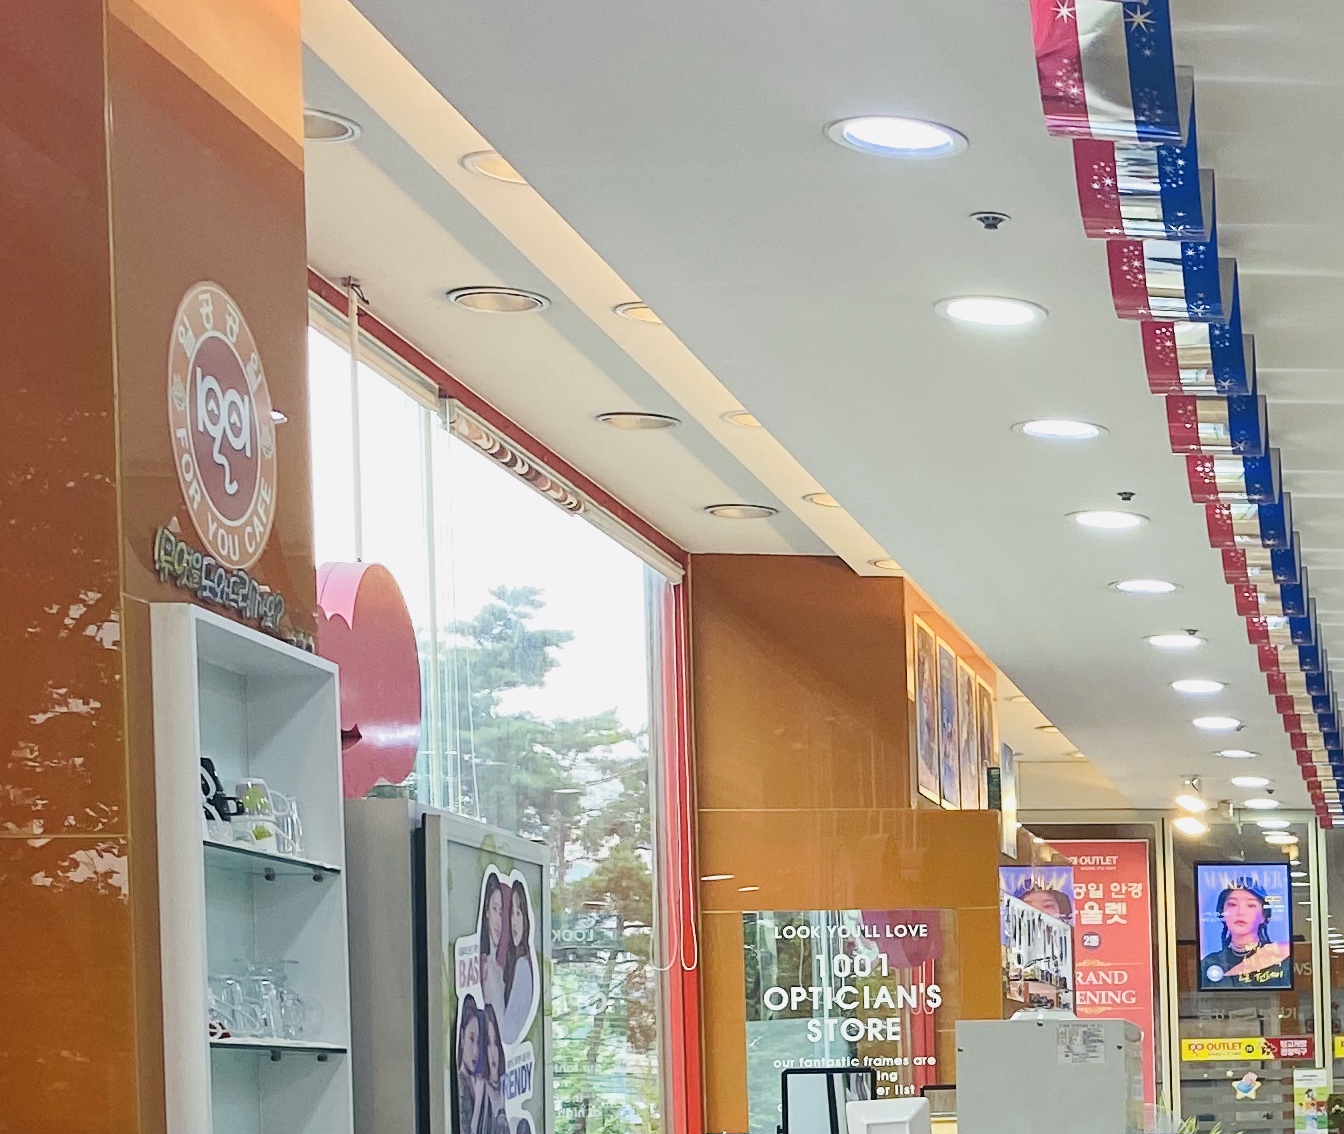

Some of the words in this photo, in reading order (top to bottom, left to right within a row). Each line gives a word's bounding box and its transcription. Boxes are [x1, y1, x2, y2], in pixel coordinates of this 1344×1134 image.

[175, 427, 202, 510] FOR
[206, 511, 240, 562] YOU
[244, 483, 273, 554] CAFE
[1079, 855, 1118, 865] OUTLET
[1074, 883, 1104, 899] 공일
[1110, 882, 1143, 899] 안경
[1075, 902, 1128, 925] 울렛
[774, 925, 821, 939] LOOK
[827, 924, 880, 939] YOU'LL
[886, 924, 928, 938] LOVE
[815, 953, 888, 978] 1001
[1076, 970, 1129, 986] RAND
[763, 983, 942, 1011] OPTICIAN'S
[1076, 991, 1137, 1005] ENING
[806, 1018, 901, 1042] STORE
[1206, 1042, 1242, 1051] OUTLET
[773, 1058, 795, 1068] our
[799, 1056, 860, 1068] fantastic
[863, 1055, 909, 1067] frames
[913, 1056, 936, 1066] are
